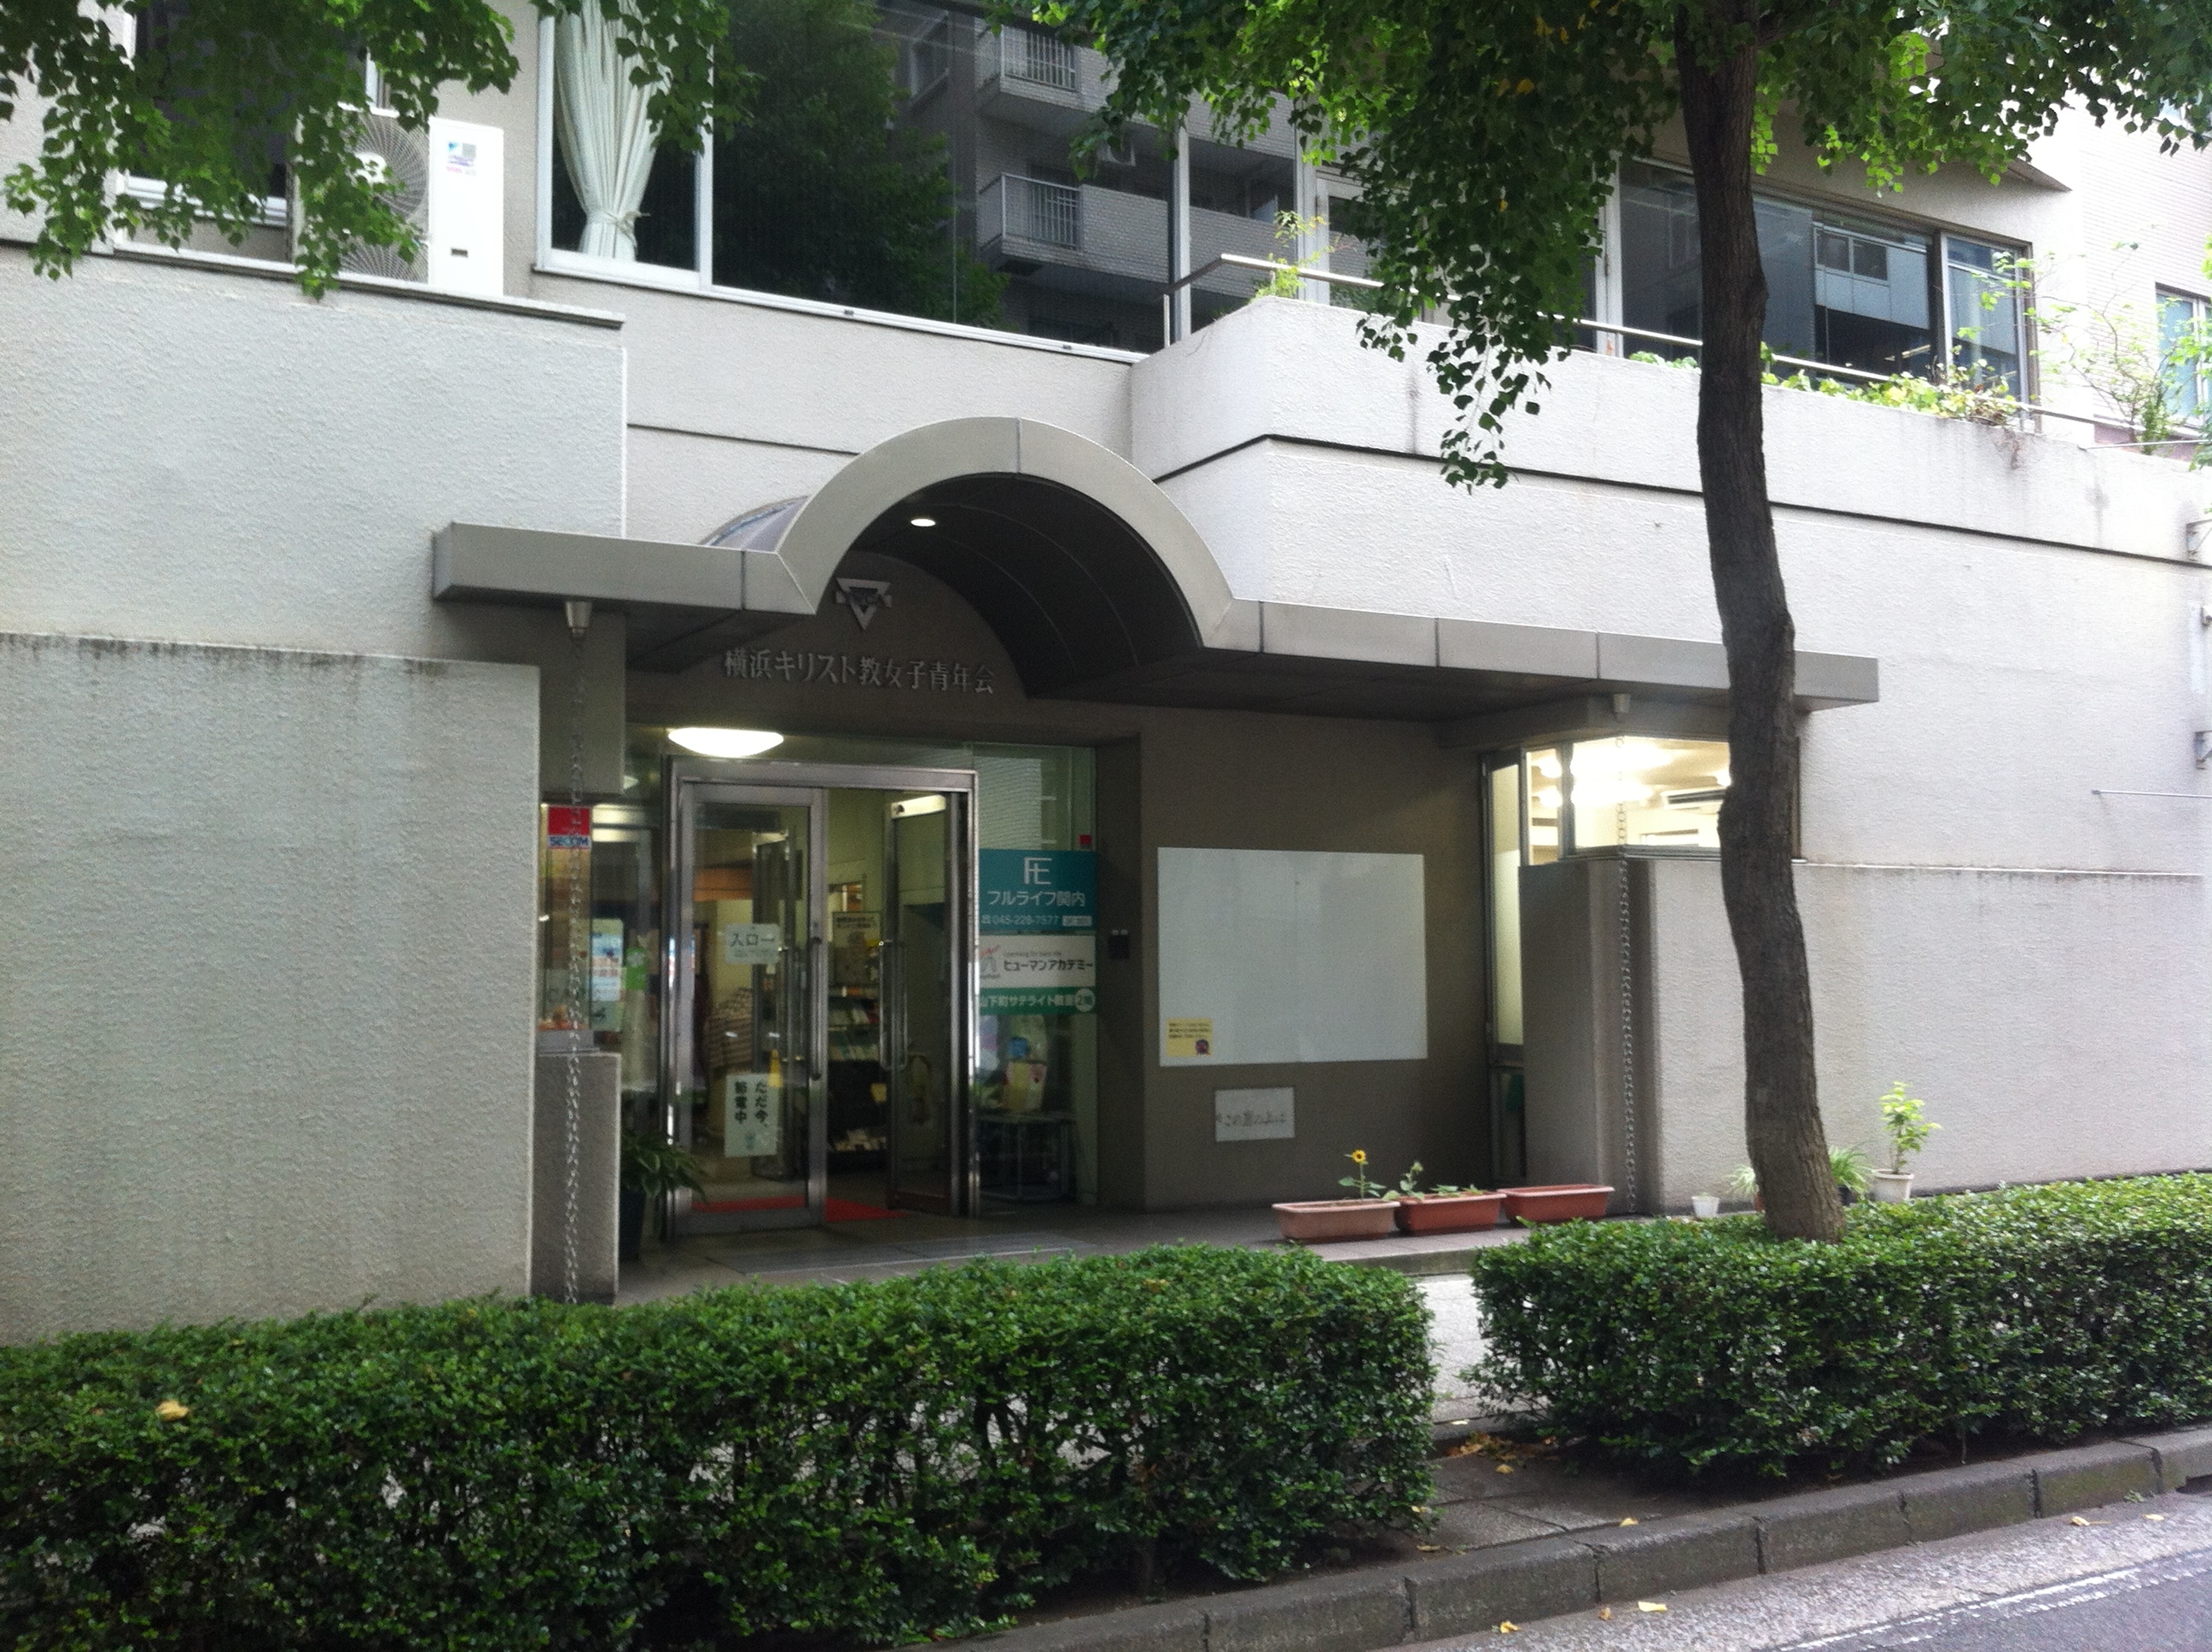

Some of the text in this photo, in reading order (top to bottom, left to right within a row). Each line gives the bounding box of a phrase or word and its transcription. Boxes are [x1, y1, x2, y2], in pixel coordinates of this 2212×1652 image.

[725, 649, 994, 695] 横浜キリスト教女子青年会
[987, 891, 1086, 907] フルライフ関内
[1003, 959, 1093, 971] ヒューマンアカデミー
